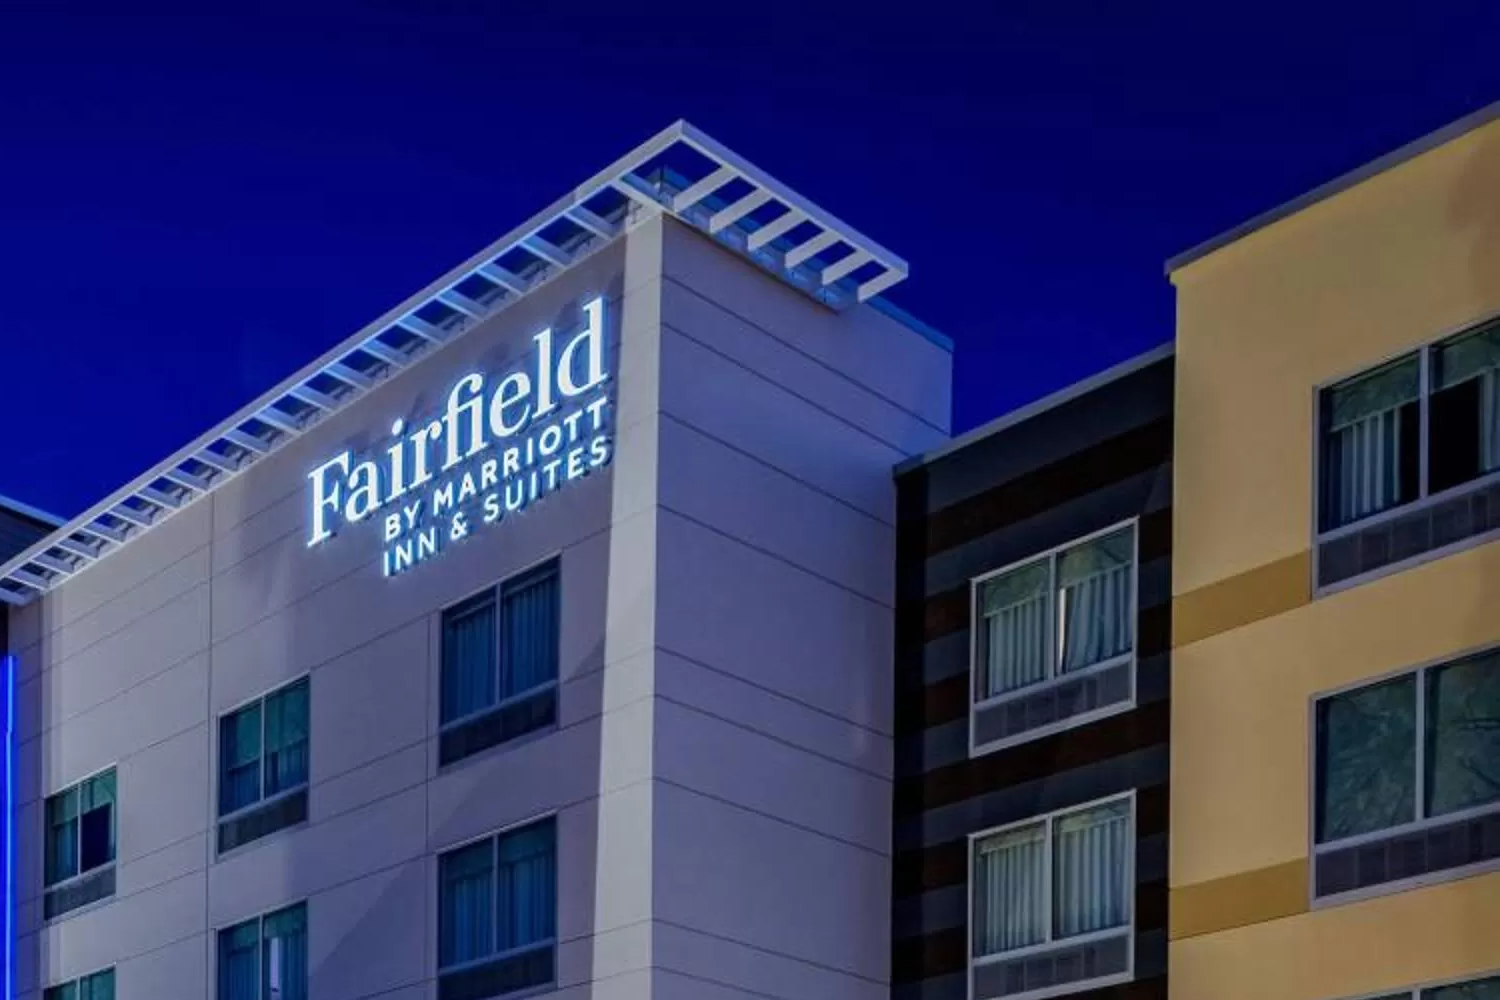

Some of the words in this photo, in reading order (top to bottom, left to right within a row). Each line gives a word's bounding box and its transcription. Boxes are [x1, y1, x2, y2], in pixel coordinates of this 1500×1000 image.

[307, 297, 608, 547] Fairfield
[385, 500, 420, 541] BY
[433, 397, 607, 515] MARRIOTT
[383, 527, 435, 577] INN
[450, 512, 468, 539] &
[484, 435, 608, 522] SUITES
